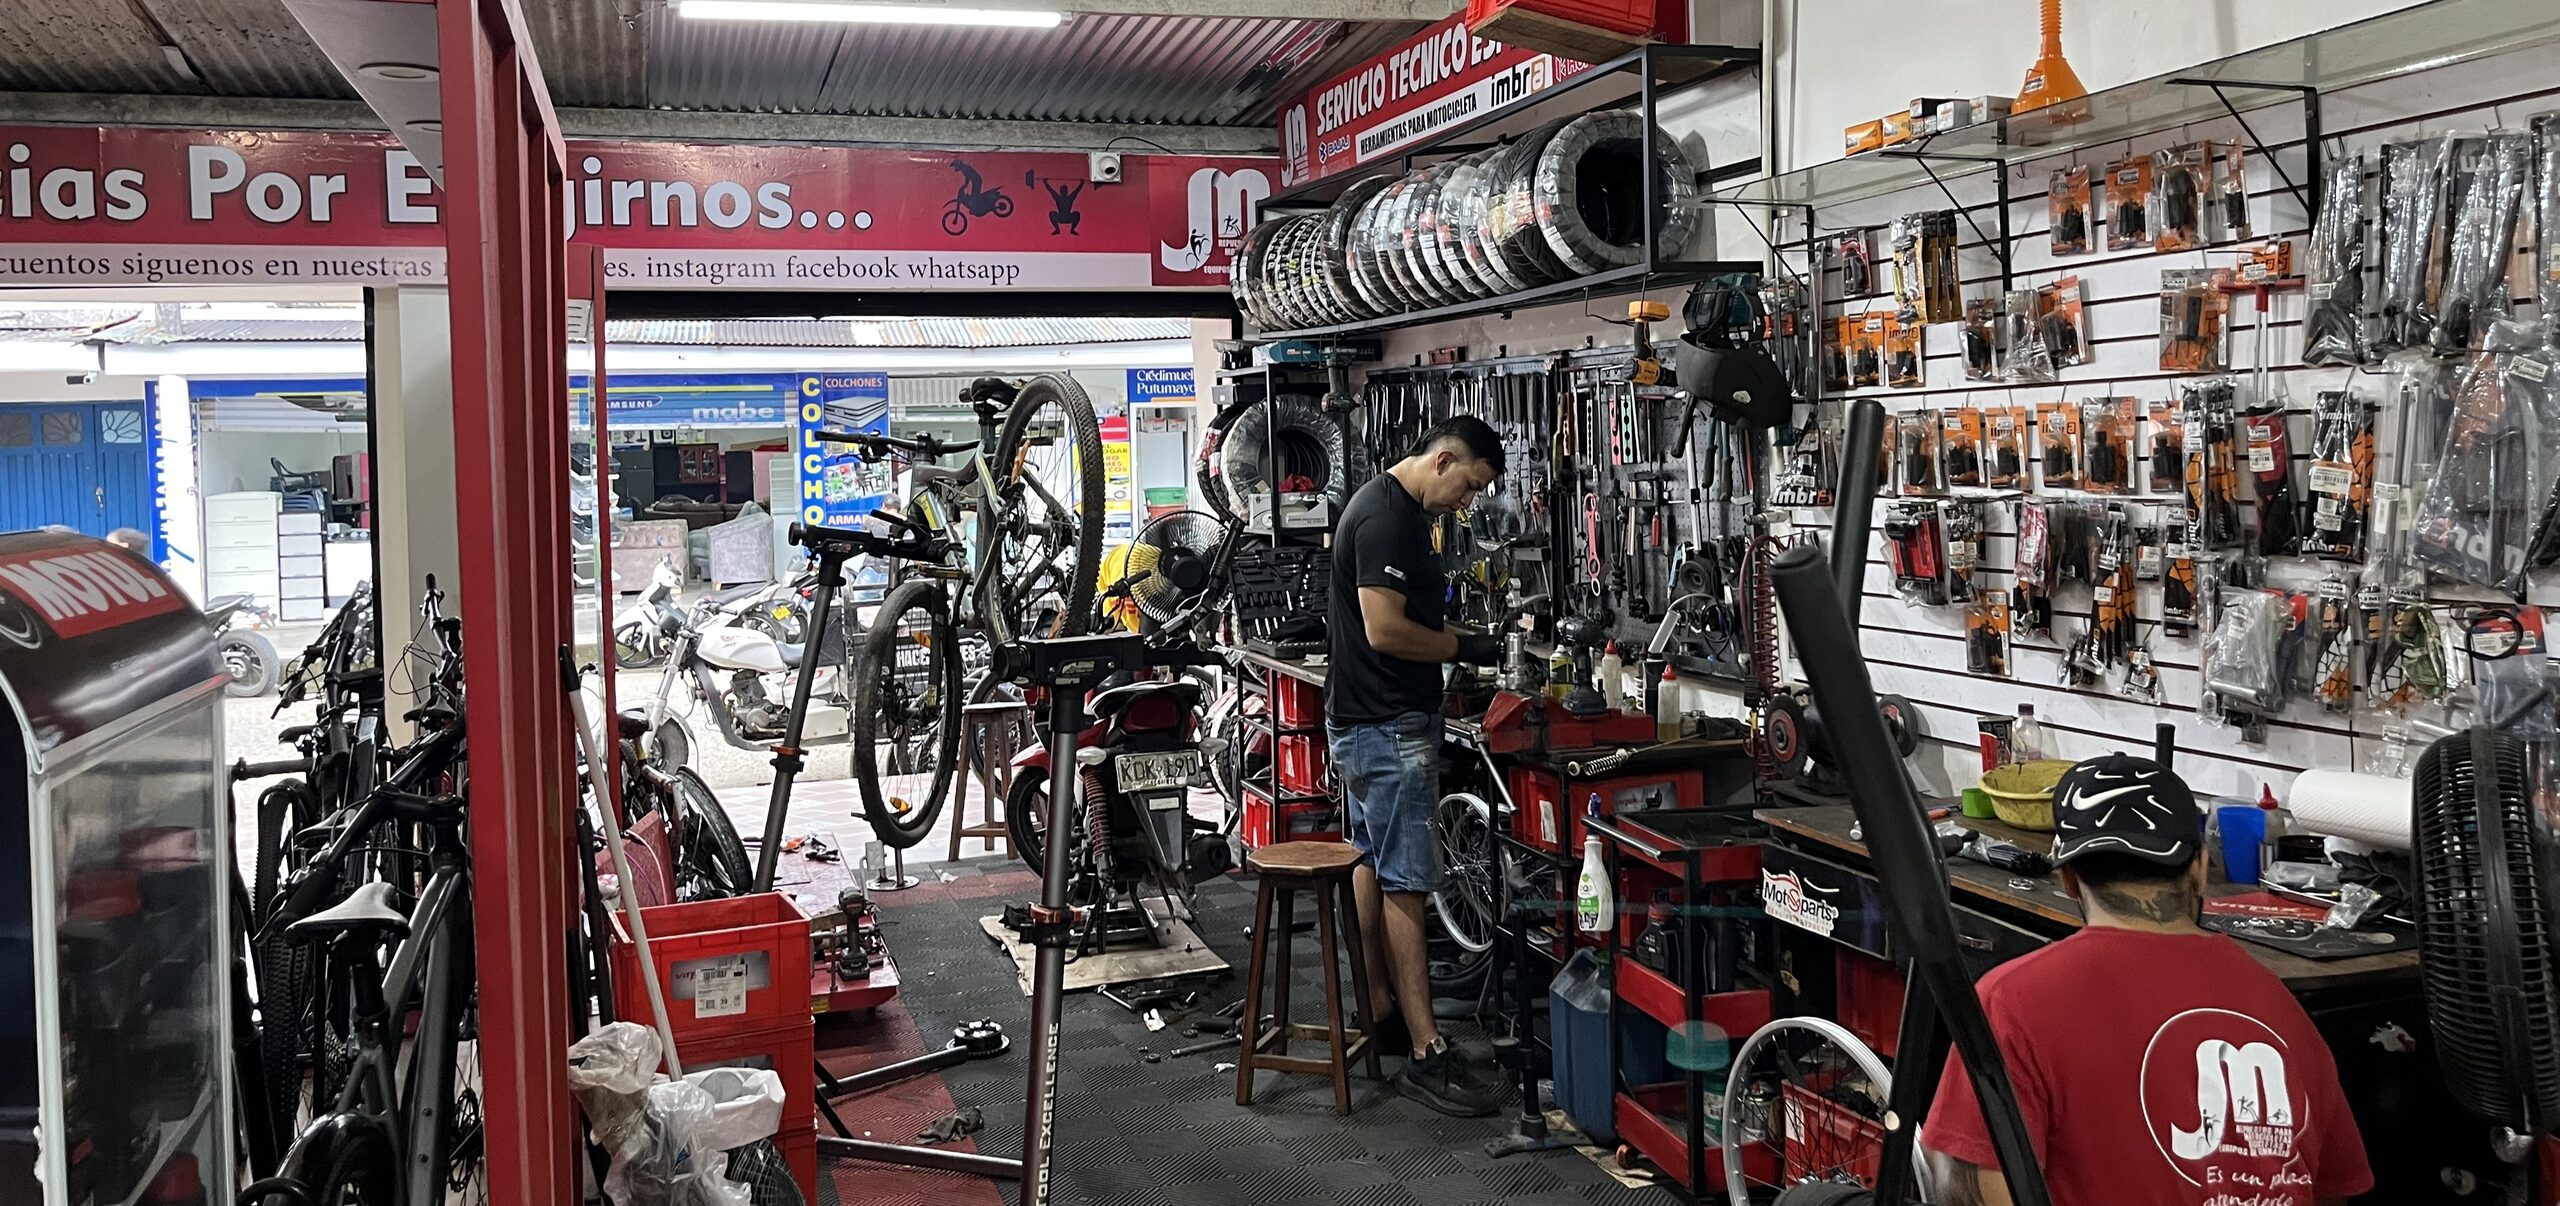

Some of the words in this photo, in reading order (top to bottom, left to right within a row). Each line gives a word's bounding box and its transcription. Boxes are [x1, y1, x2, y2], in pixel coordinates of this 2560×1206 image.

[1316, 63, 1385, 138] SERVICIO
[1389, 22, 1467, 101] TECNICO
[1490, 56, 1546, 108] imbra
[1360, 121, 1407, 157] HERRAMIENTAS
[1408, 117, 1427, 136] PARA
[1427, 92, 1478, 130] MOTOCICLETA
[0, 142, 147, 221] ias
[188, 144, 347, 224] Por
[1218, 238, 1243, 248] REPUES
[122, 252, 254, 283] siguenos
[265, 257, 299, 277] en
[312, 255, 432, 278] nuestras
[646, 256, 777, 285] instagram
[786, 255, 900, 279] facebook
[907, 256, 1021, 286] whatsapp
[825, 377, 883, 389] COLCHONES
[606, 400, 654, 410] AMSUNG
[692, 400, 775, 420] mabe
[0, 550, 168, 621] MOTUL
[1039, 1022, 1060, 1151] EXCELLENCE
[2206, 1165, 2223, 1185] Es
[2231, 1171, 2265, 1187] un
